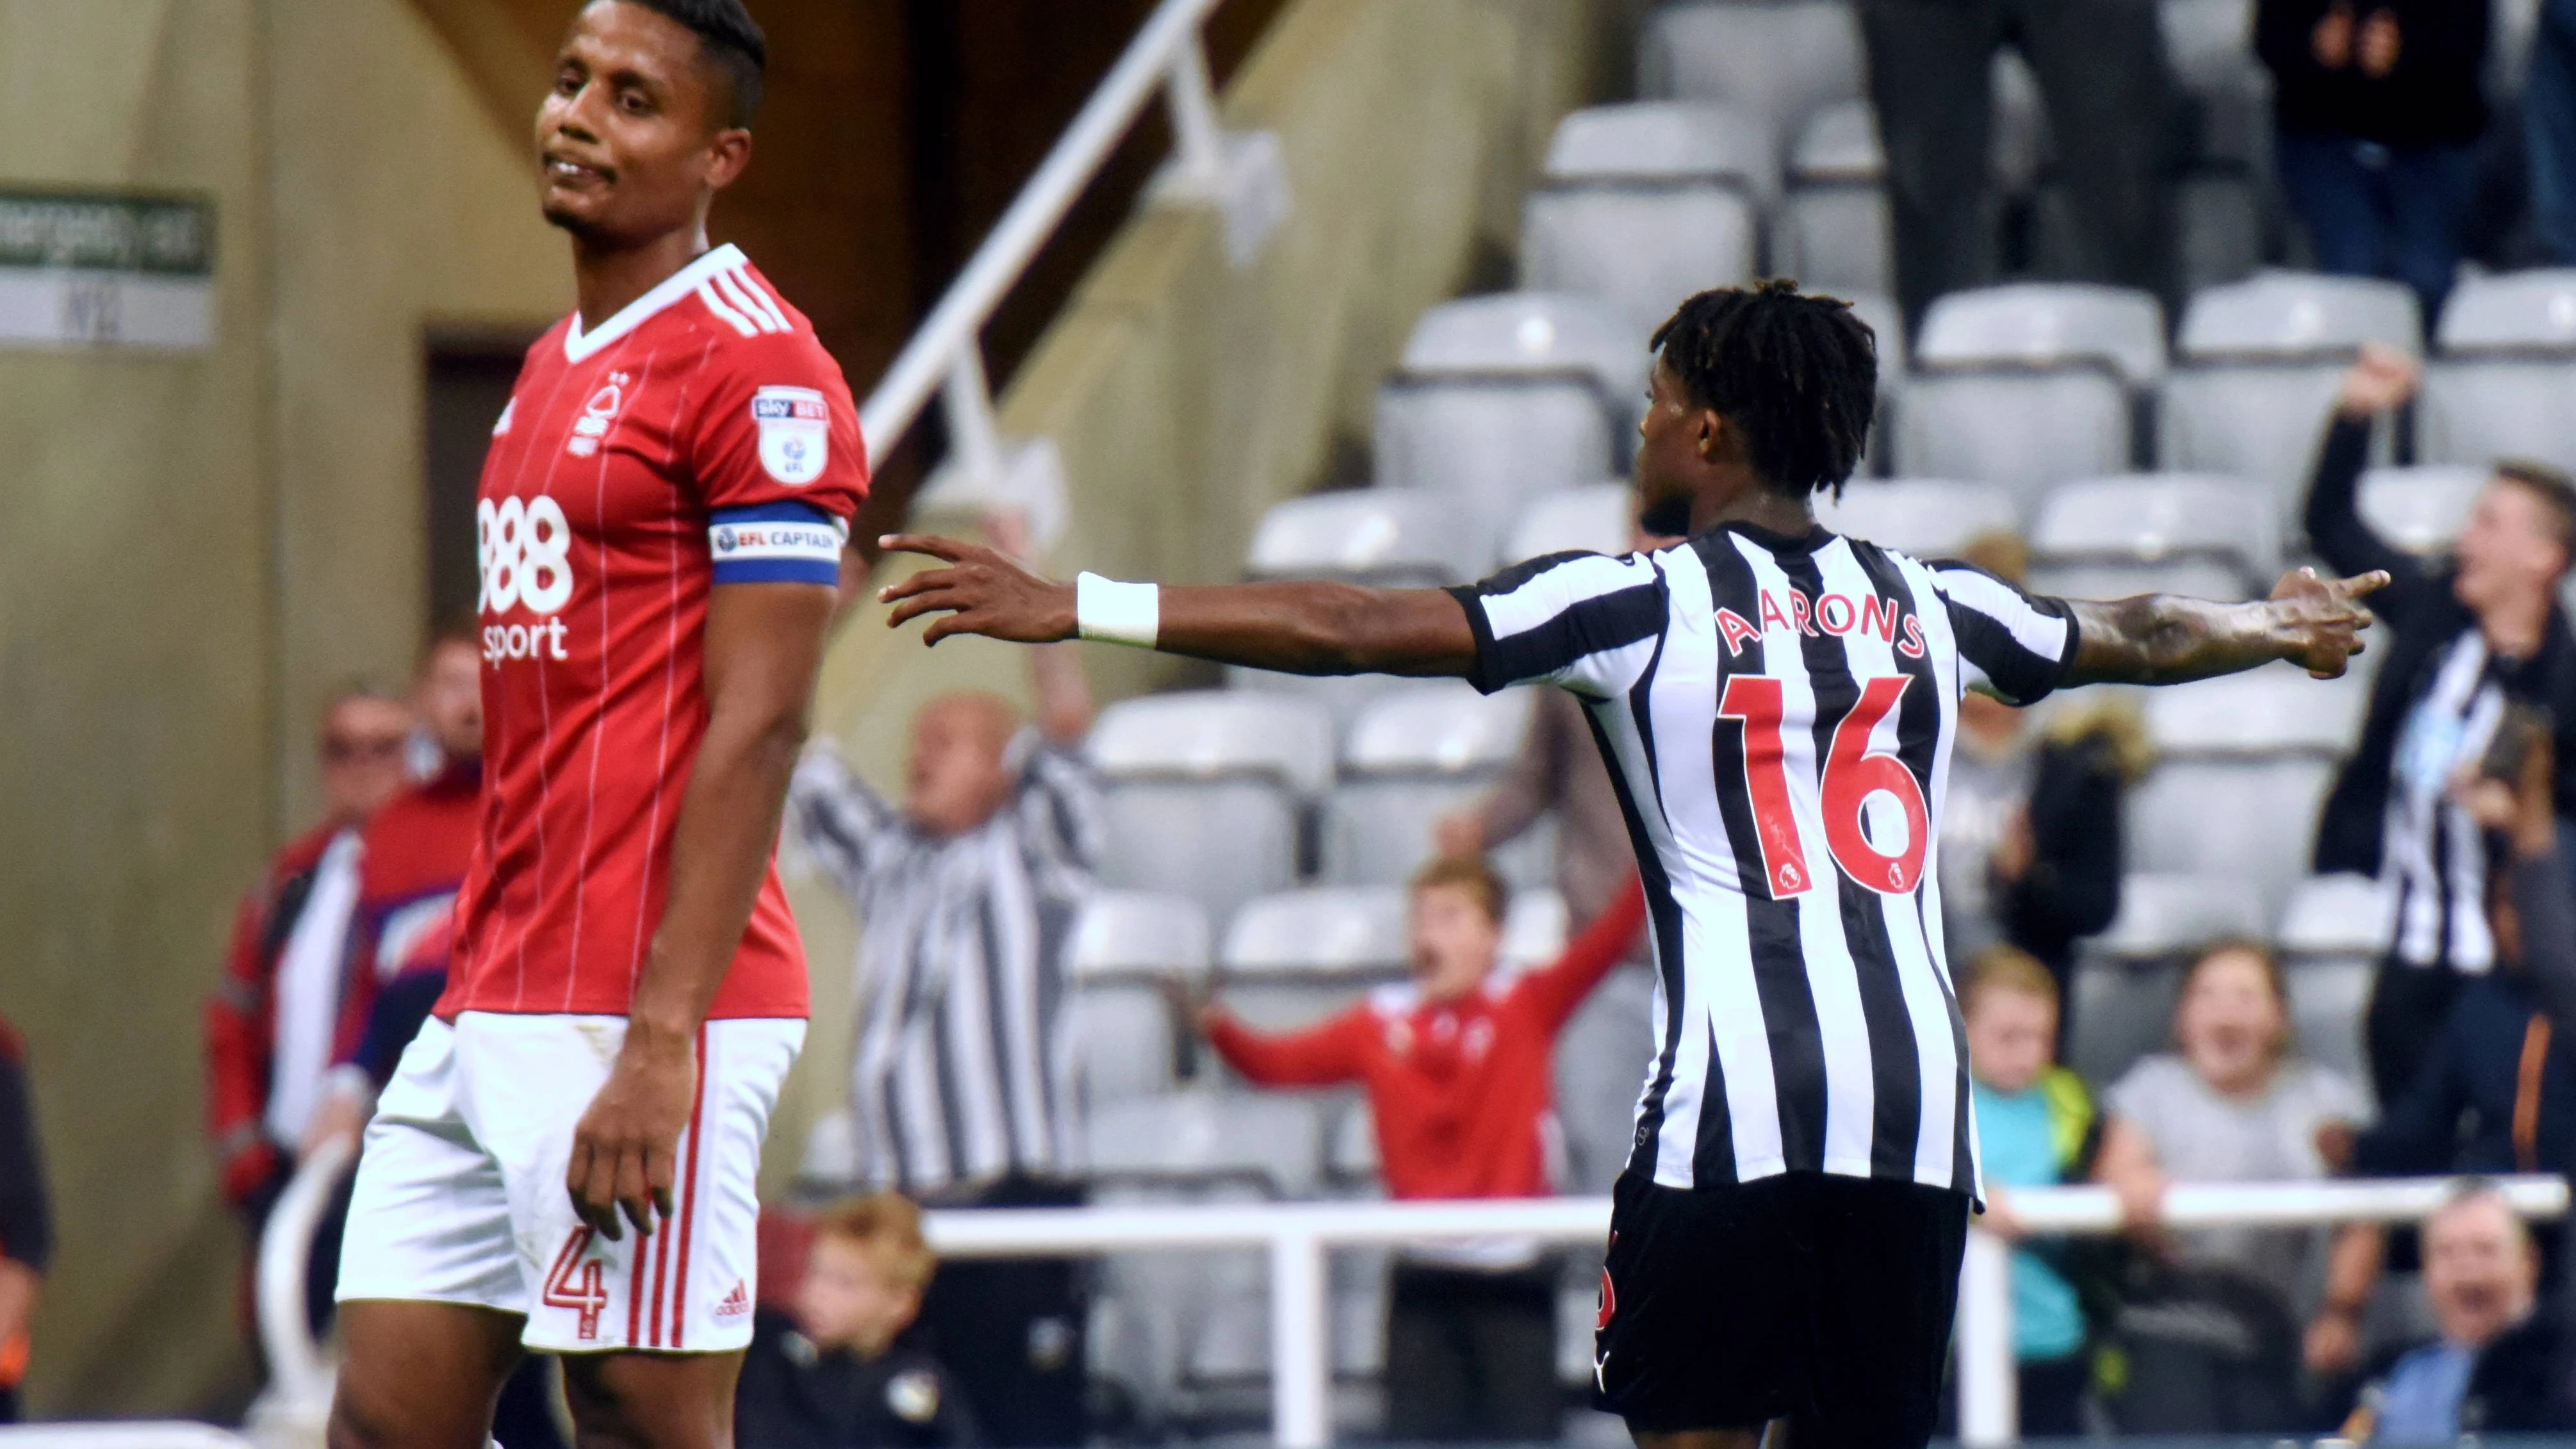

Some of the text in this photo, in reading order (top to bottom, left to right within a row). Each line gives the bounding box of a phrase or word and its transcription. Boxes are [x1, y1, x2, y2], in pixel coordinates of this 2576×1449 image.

[738, 531, 766, 546] EFL
[484, 616, 568, 670] sport
[1714, 588, 1924, 659] AARONS
[1717, 674, 1930, 900] 16
[543, 1225, 607, 1339] 4
